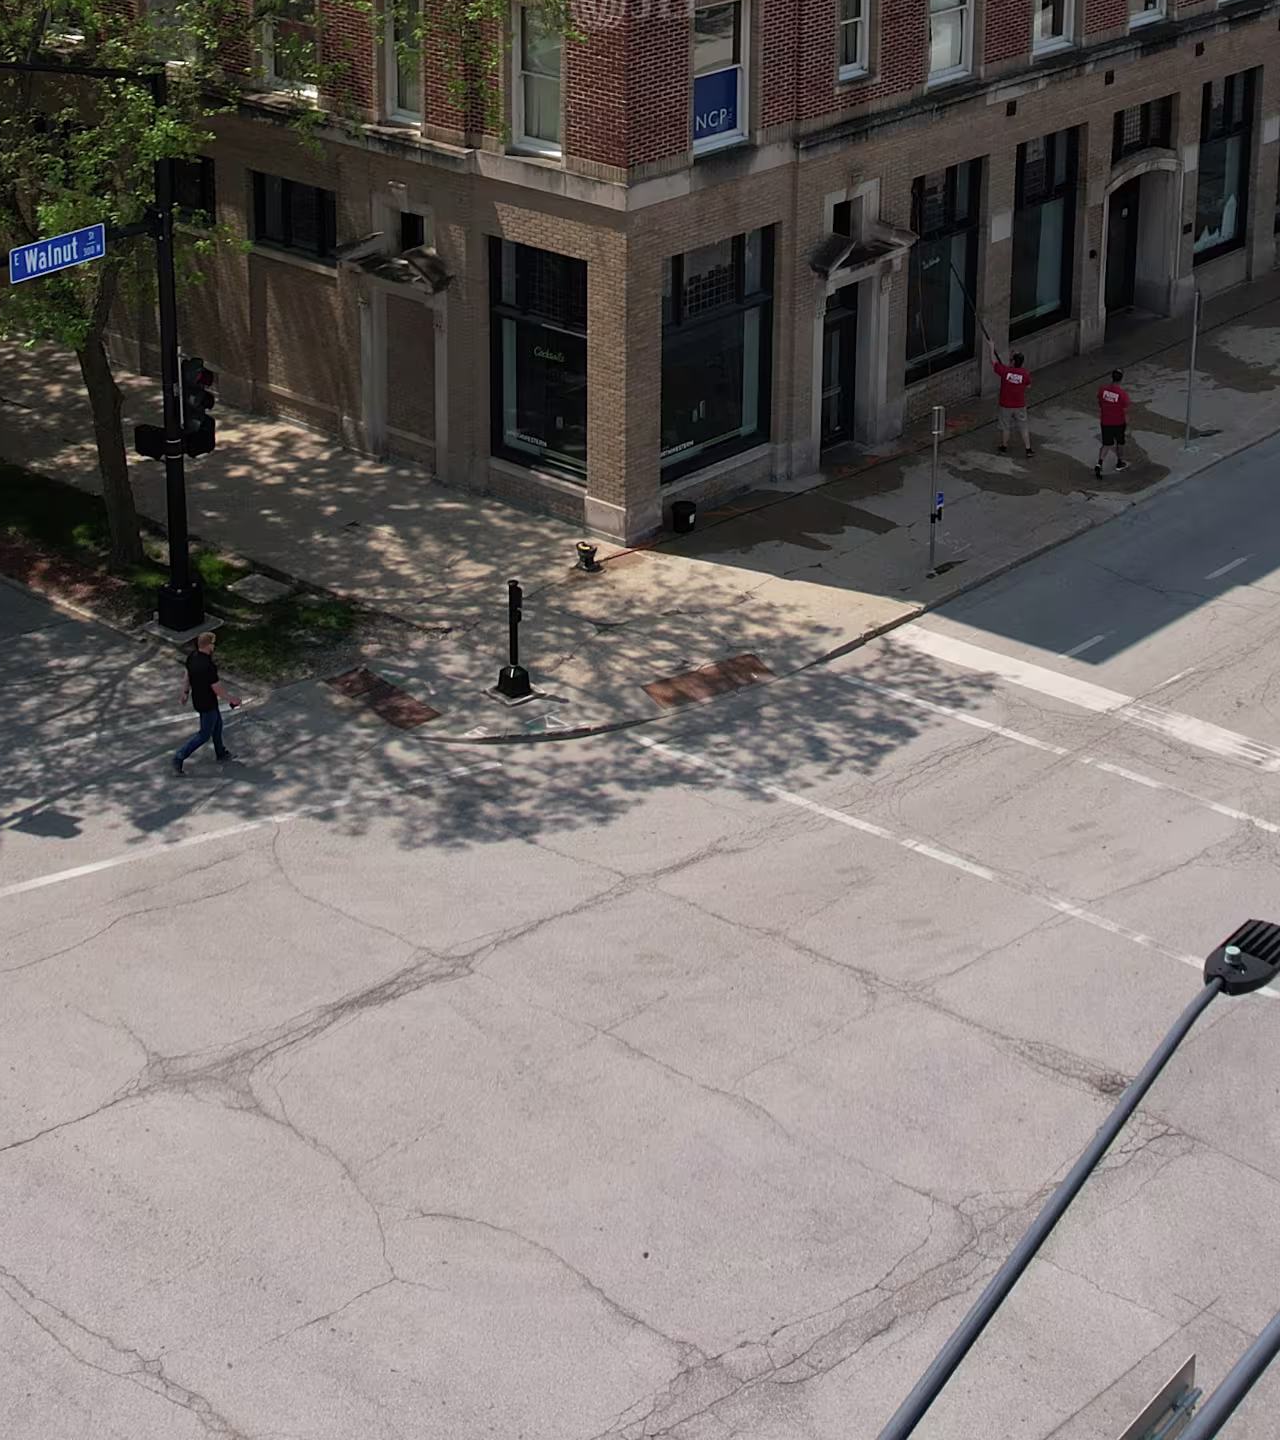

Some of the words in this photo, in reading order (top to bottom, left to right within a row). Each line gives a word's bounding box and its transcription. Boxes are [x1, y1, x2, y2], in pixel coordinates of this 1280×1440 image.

[696, 108, 727, 131] NCP
[14, 253, 20, 266] E
[25, 236, 78, 273] Walnut
